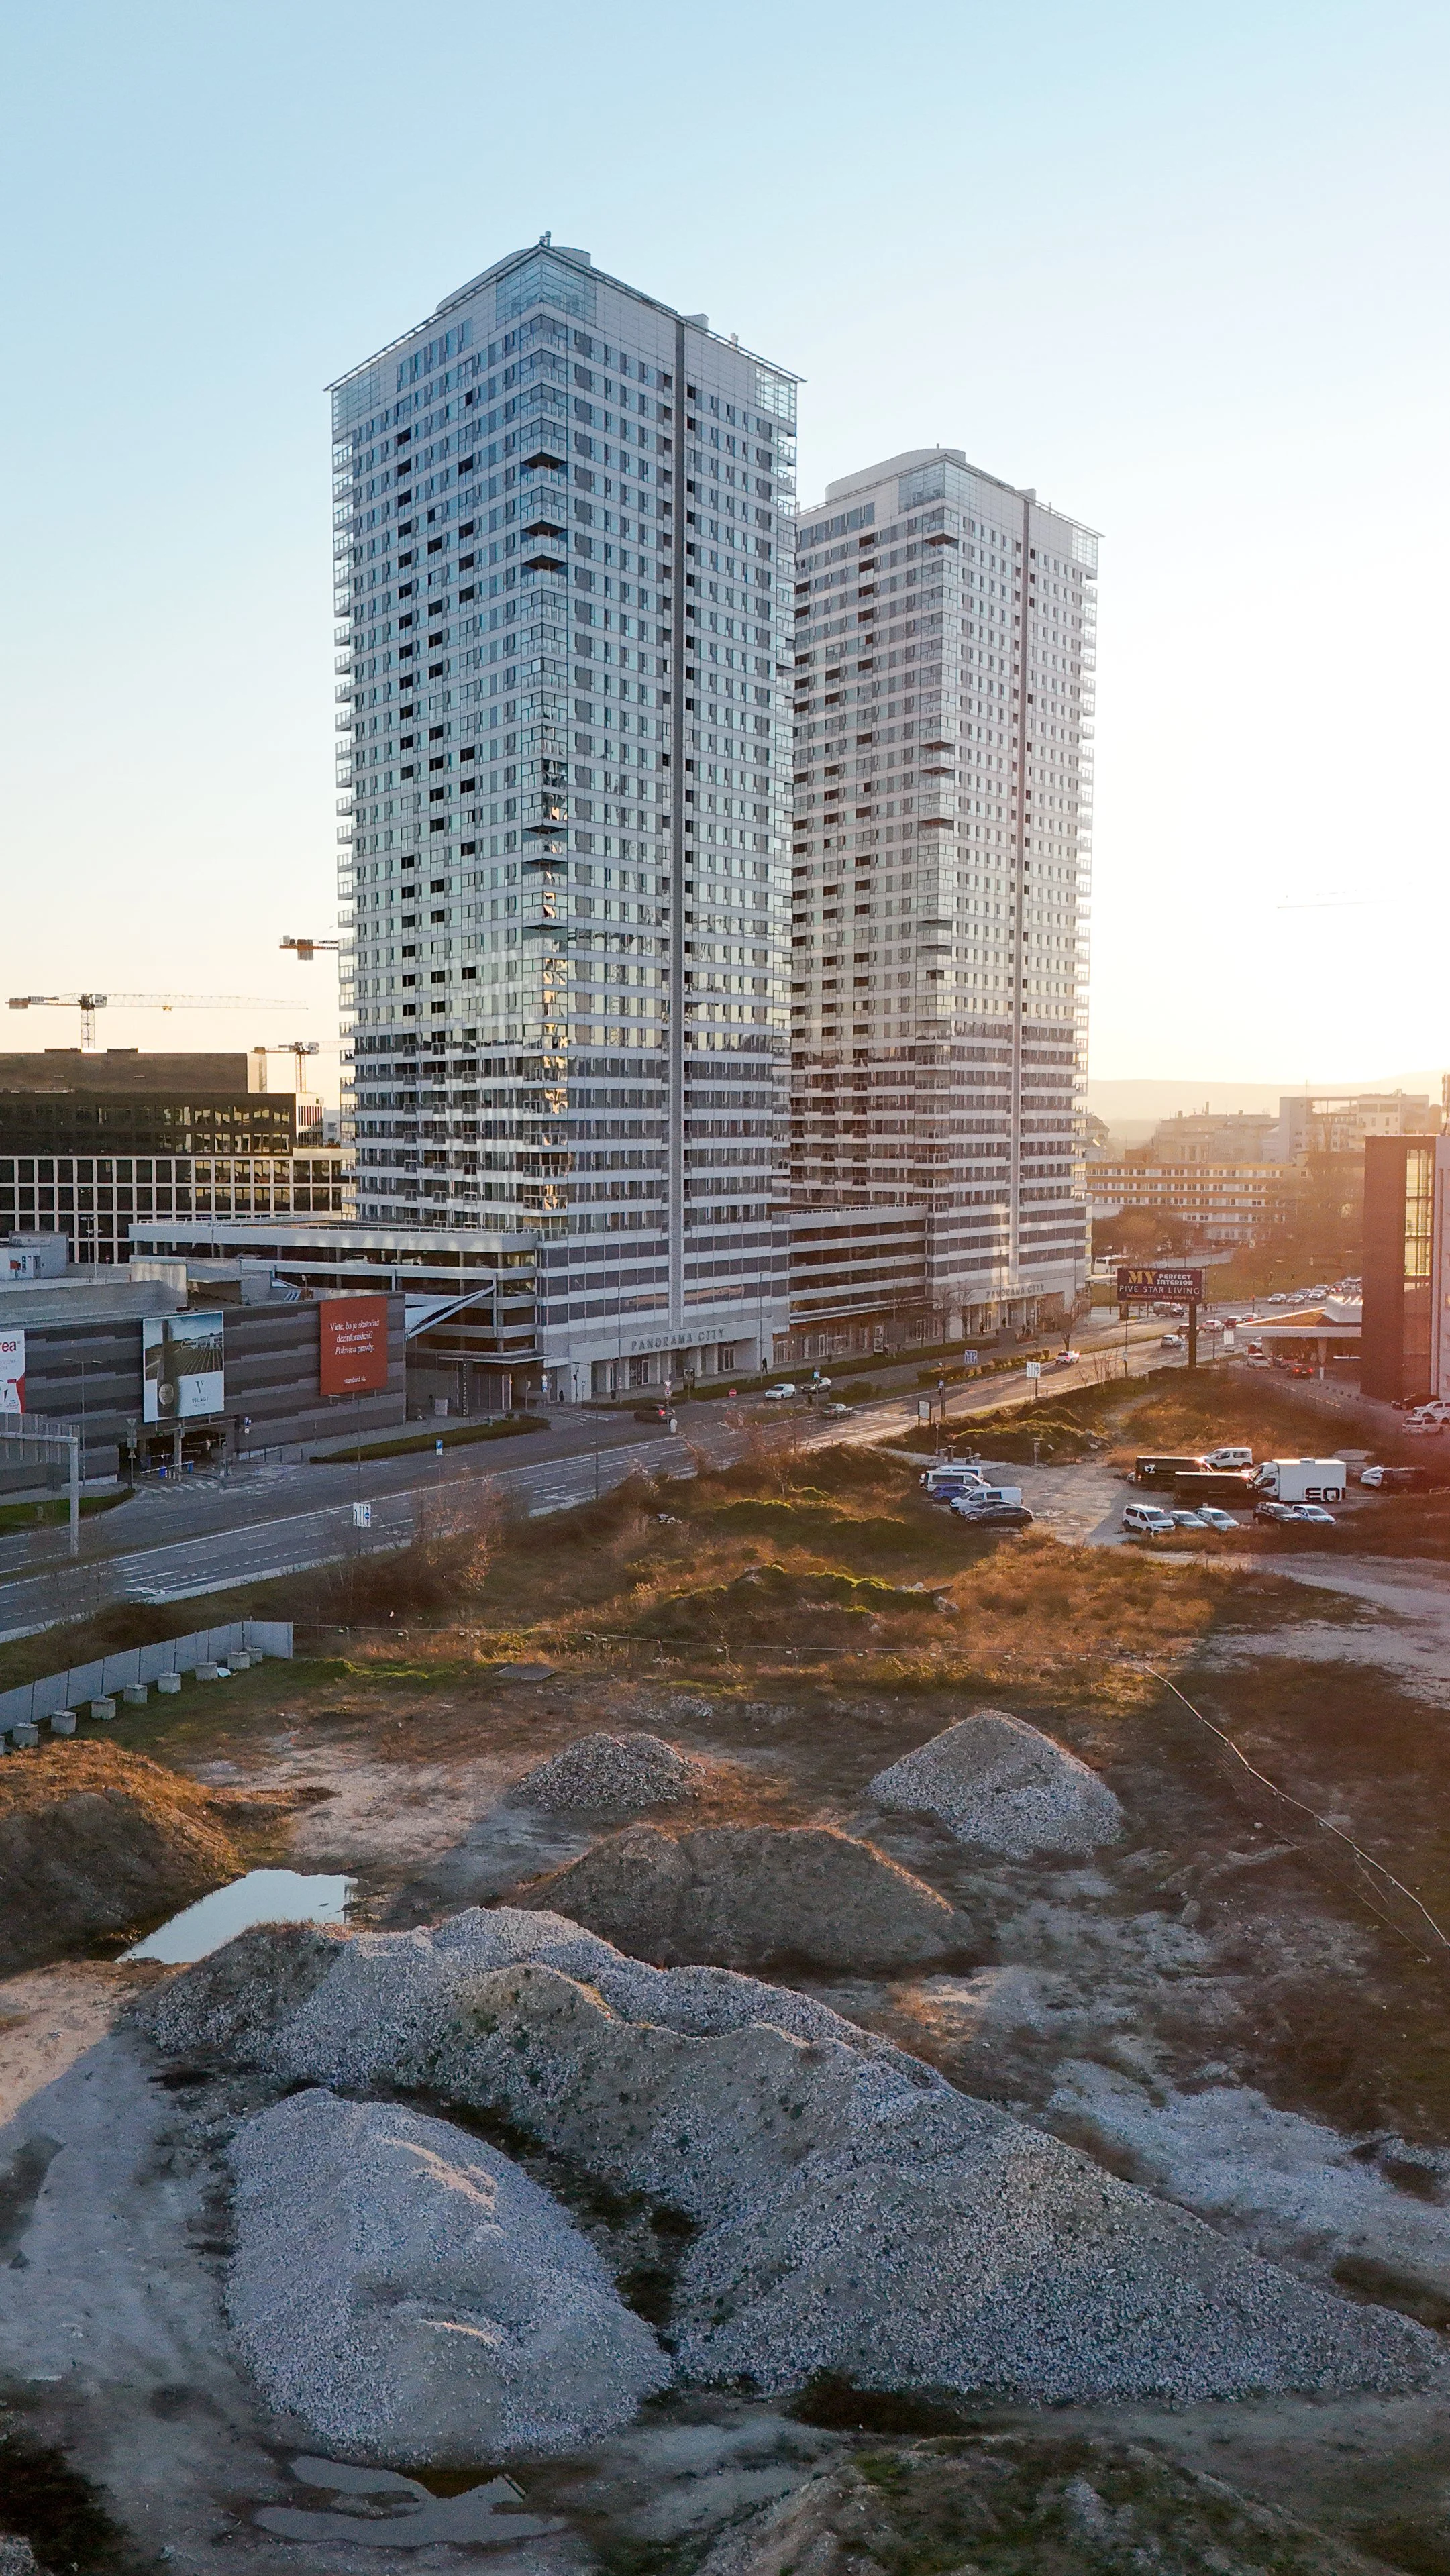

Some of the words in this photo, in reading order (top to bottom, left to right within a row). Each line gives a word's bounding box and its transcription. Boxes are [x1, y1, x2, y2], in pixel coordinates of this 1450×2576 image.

[1129, 1271, 1157, 1284] MY
[986, 1287, 1025, 1299] PANORAMA
[1028, 1284, 1044, 1293] CITY
[1119, 1285, 1139, 1293] FIVE
[631, 1332, 693, 1351] PANORAMA
[698, 1328, 724, 1342] CITY
